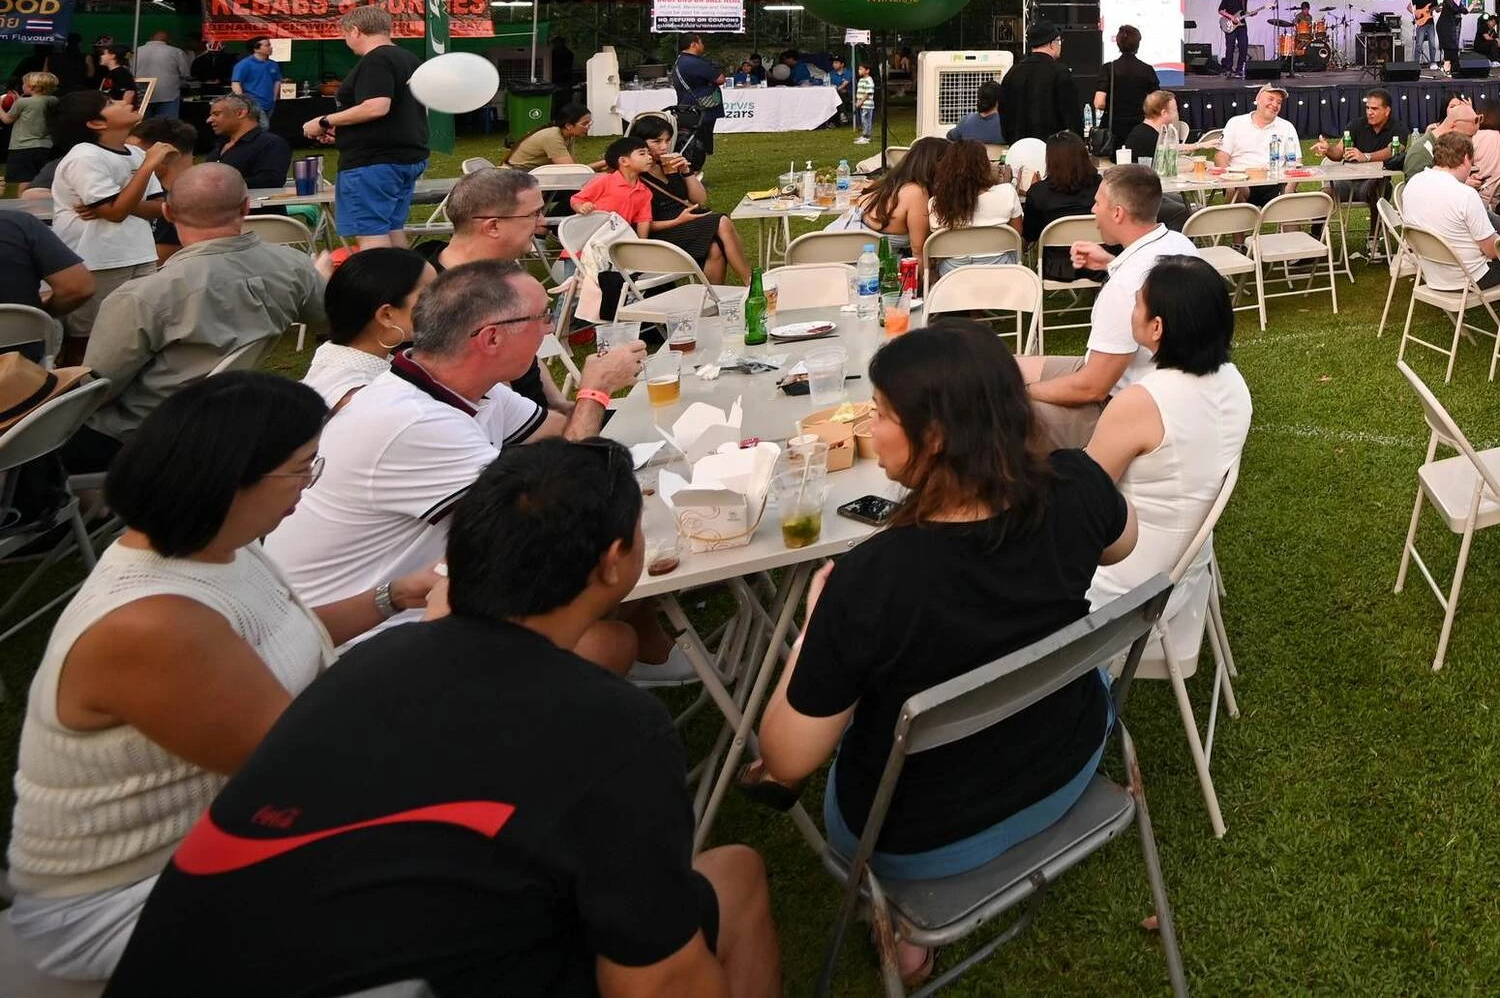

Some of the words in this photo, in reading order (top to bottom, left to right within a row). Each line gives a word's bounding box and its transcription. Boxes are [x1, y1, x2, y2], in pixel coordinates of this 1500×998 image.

[12, 33, 55, 41] Flavours
[723, 101, 755, 110] orvis
[725, 110, 754, 118] zars
